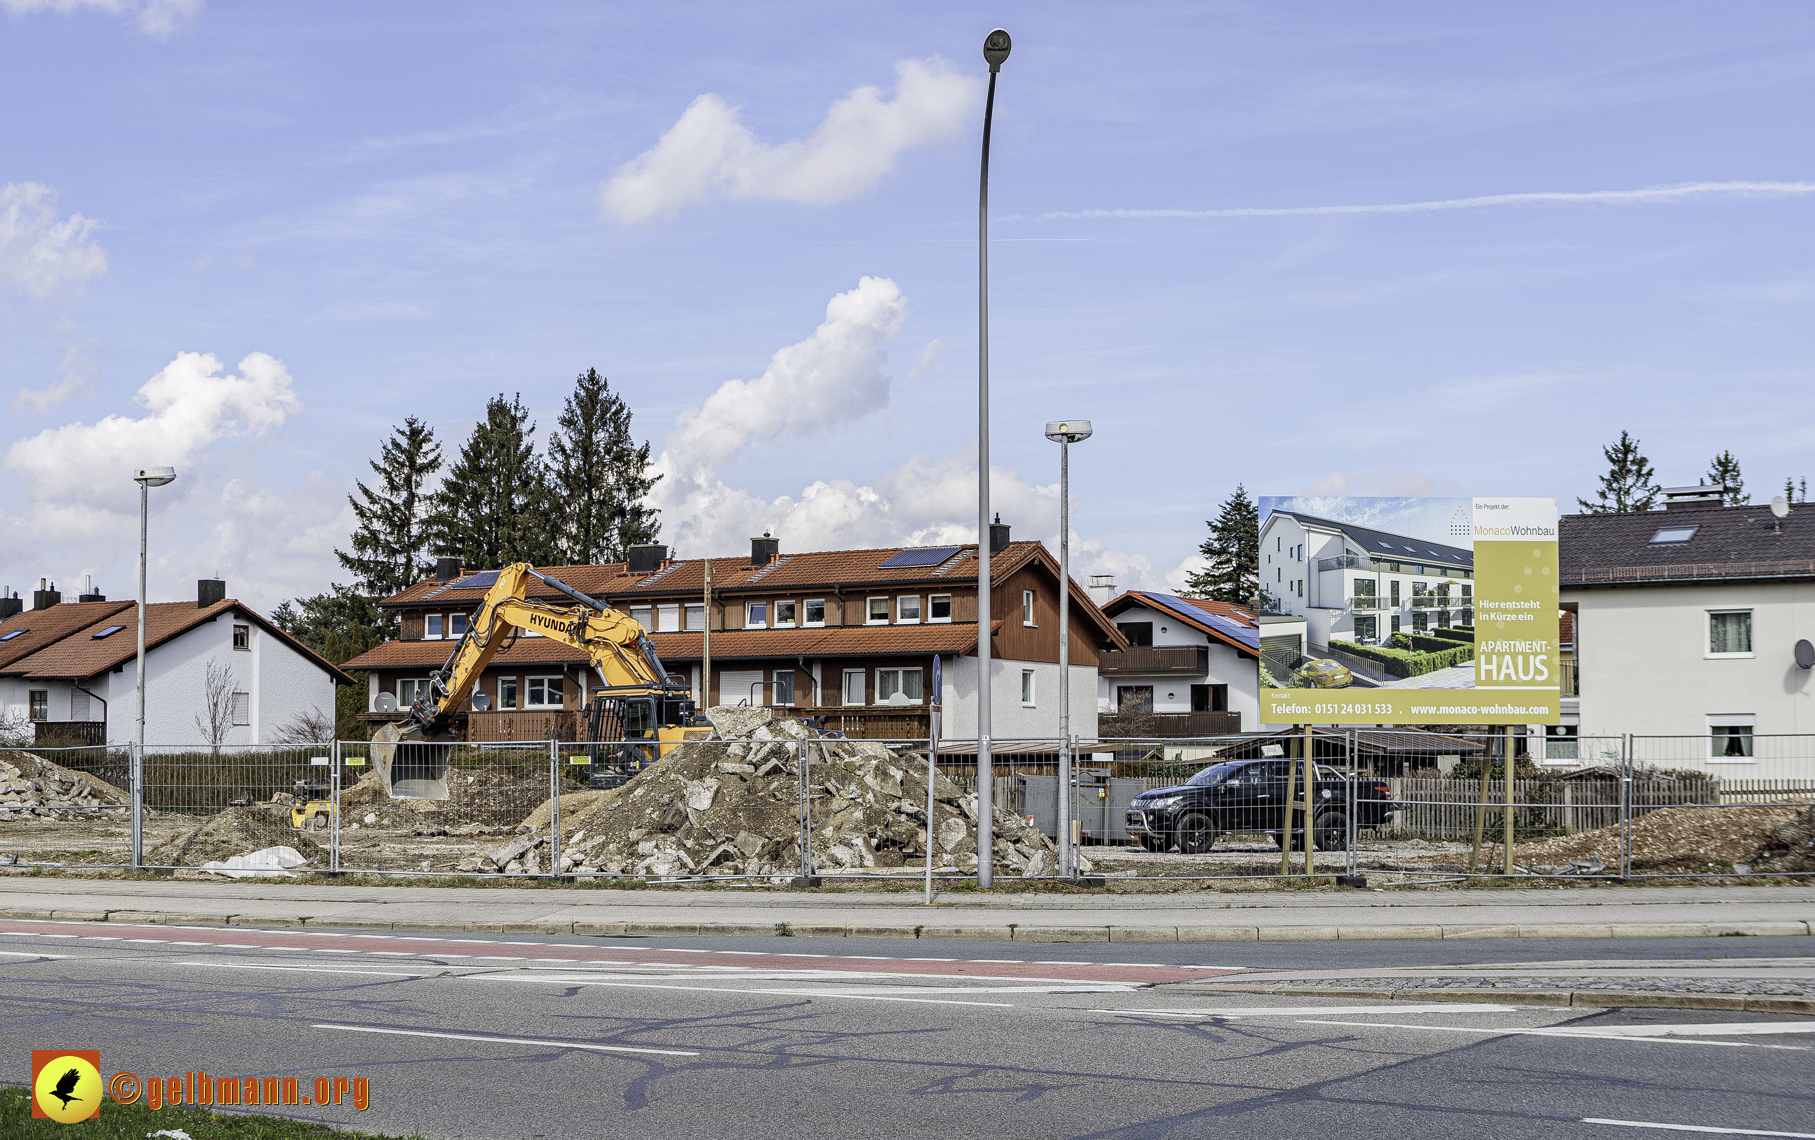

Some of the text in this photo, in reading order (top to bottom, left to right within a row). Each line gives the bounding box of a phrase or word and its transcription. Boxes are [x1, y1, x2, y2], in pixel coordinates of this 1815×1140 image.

[1484, 503, 1500, 511] Projekt
[1474, 525, 1555, 536] MonacoWohnbau
[1479, 600, 1541, 609] Hier entsteht
[1480, 612, 1534, 621] in Kürze ein
[530, 613, 578, 634] HYUNDA
[1480, 641, 1551, 653] APARTMENT-
[1480, 654, 1549, 681] HAUS
[1271, 703, 1549, 715] Telefon: 0151 24 031 533 www.monaco-wohnbau.com
